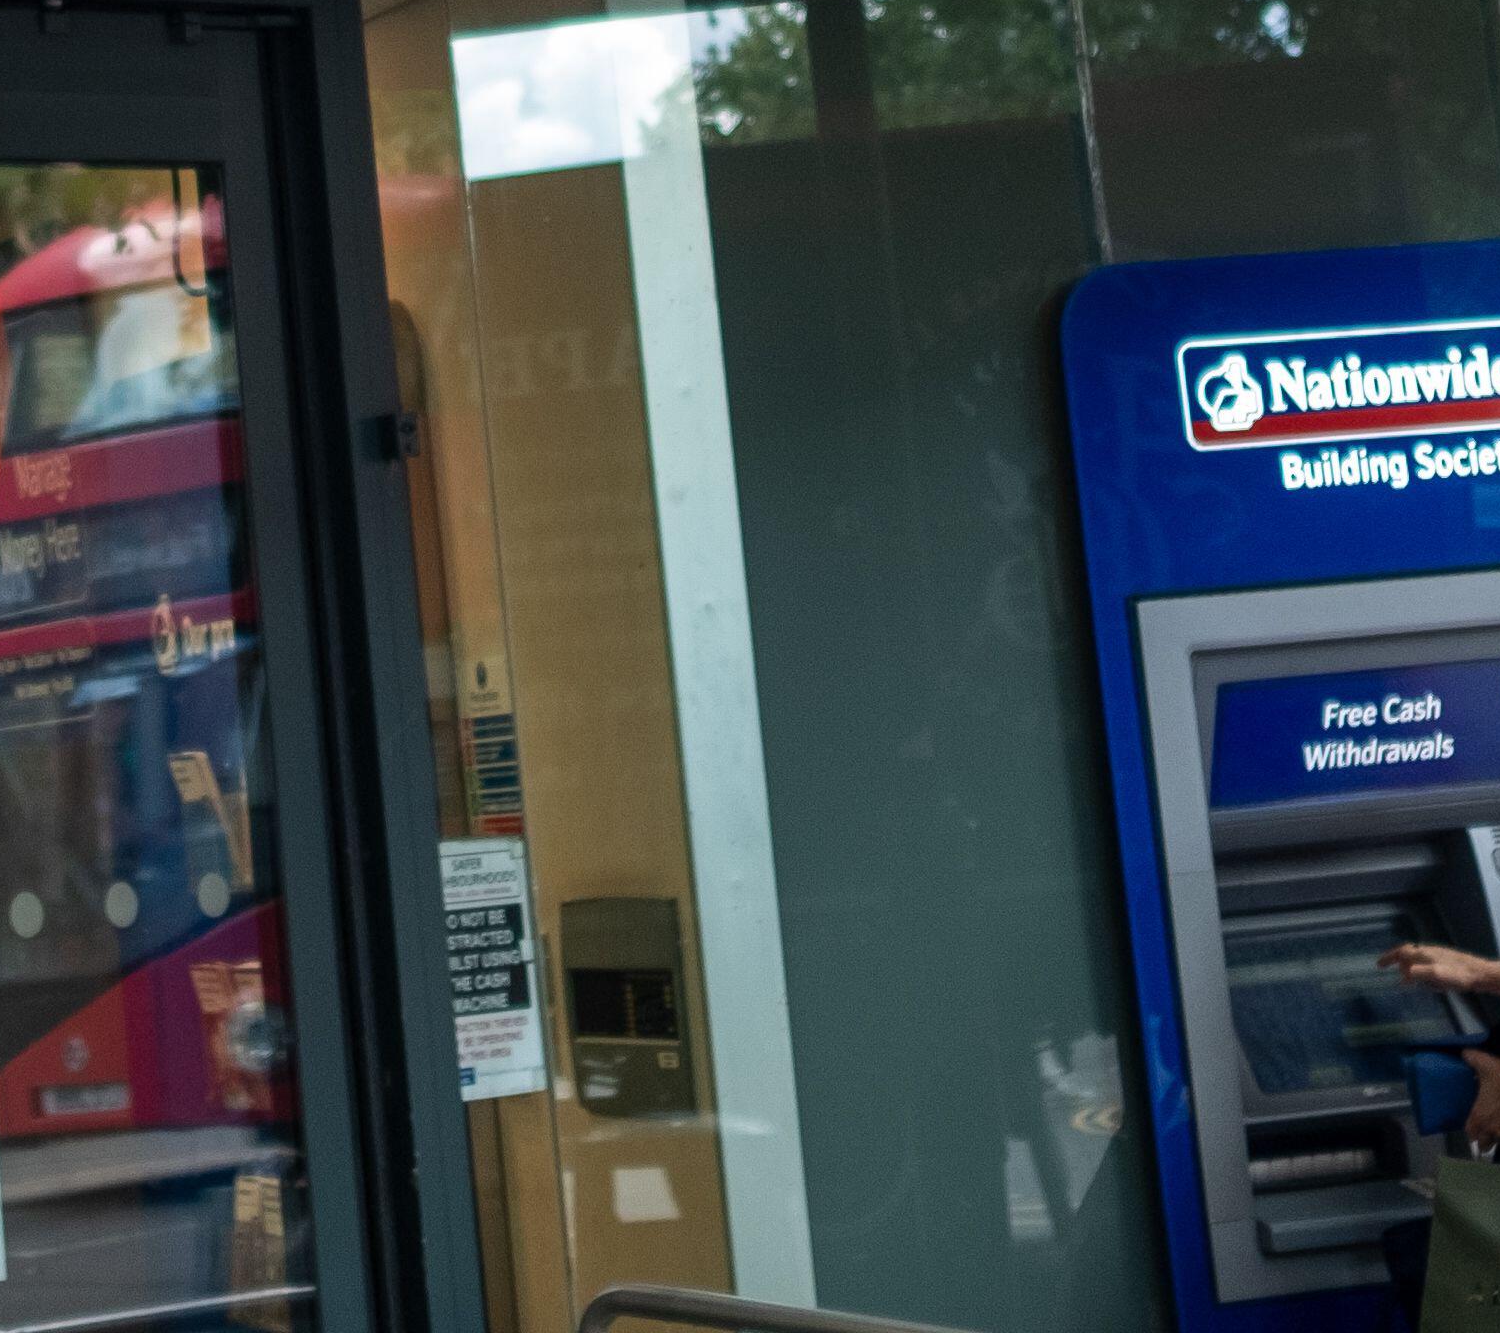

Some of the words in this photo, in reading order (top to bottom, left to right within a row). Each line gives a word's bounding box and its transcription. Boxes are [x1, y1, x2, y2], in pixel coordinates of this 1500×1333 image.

[1280, 449, 1408, 491] Building
[1322, 699, 1377, 730] Free
[1383, 691, 1441, 725] Cash
[1303, 730, 1455, 772] Withdrawals
[460, 910, 486, 927] NOT
[487, 908, 506, 925] BE
[447, 929, 515, 951] STRACTED
[481, 949, 522, 968] USING
[474, 971, 511, 990] CASH
